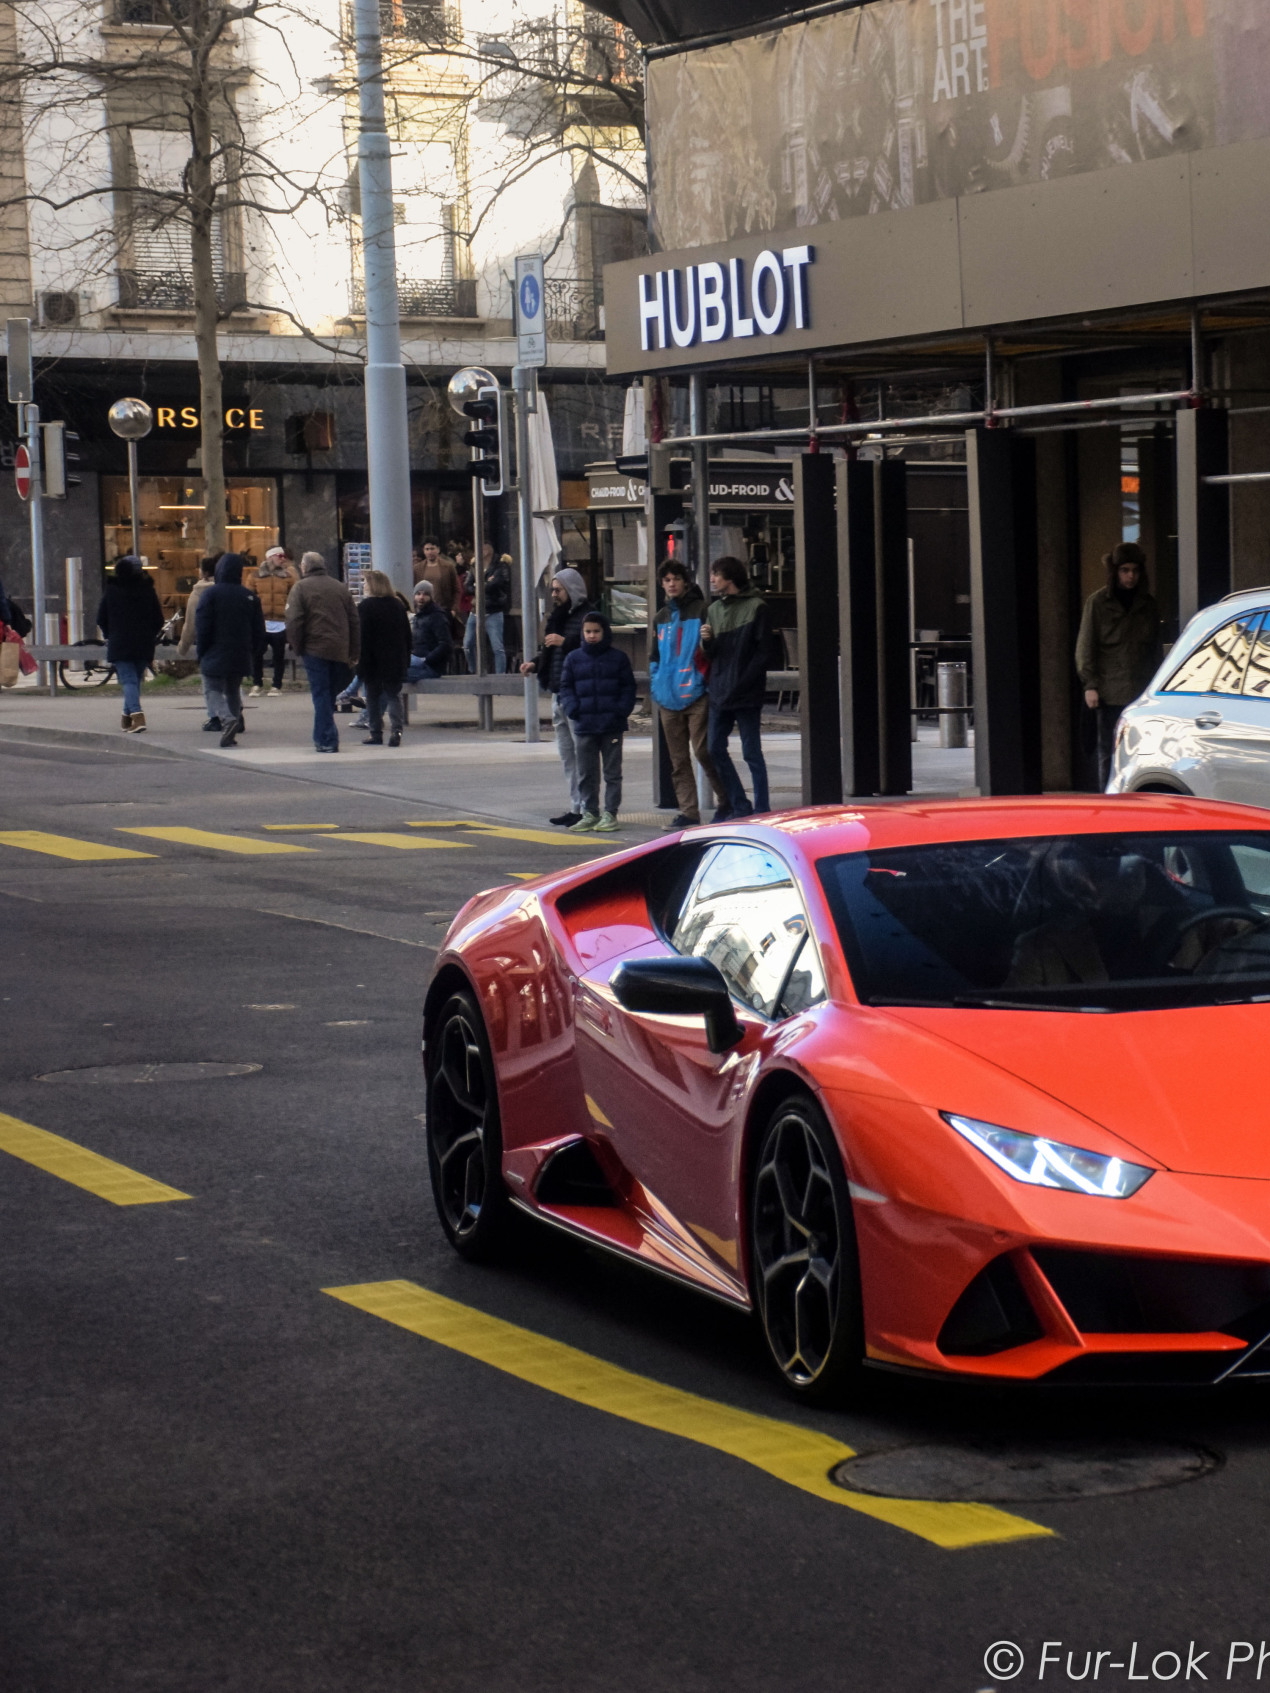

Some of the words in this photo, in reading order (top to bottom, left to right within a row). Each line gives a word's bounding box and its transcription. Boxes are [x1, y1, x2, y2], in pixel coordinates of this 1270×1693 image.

[930, 0, 988, 48] THE
[933, 36, 988, 103] ART
[639, 245, 814, 351] HUBLOT
[157, 407, 264, 429] RSCE
[684, 483, 770, 496] UD-FROID
